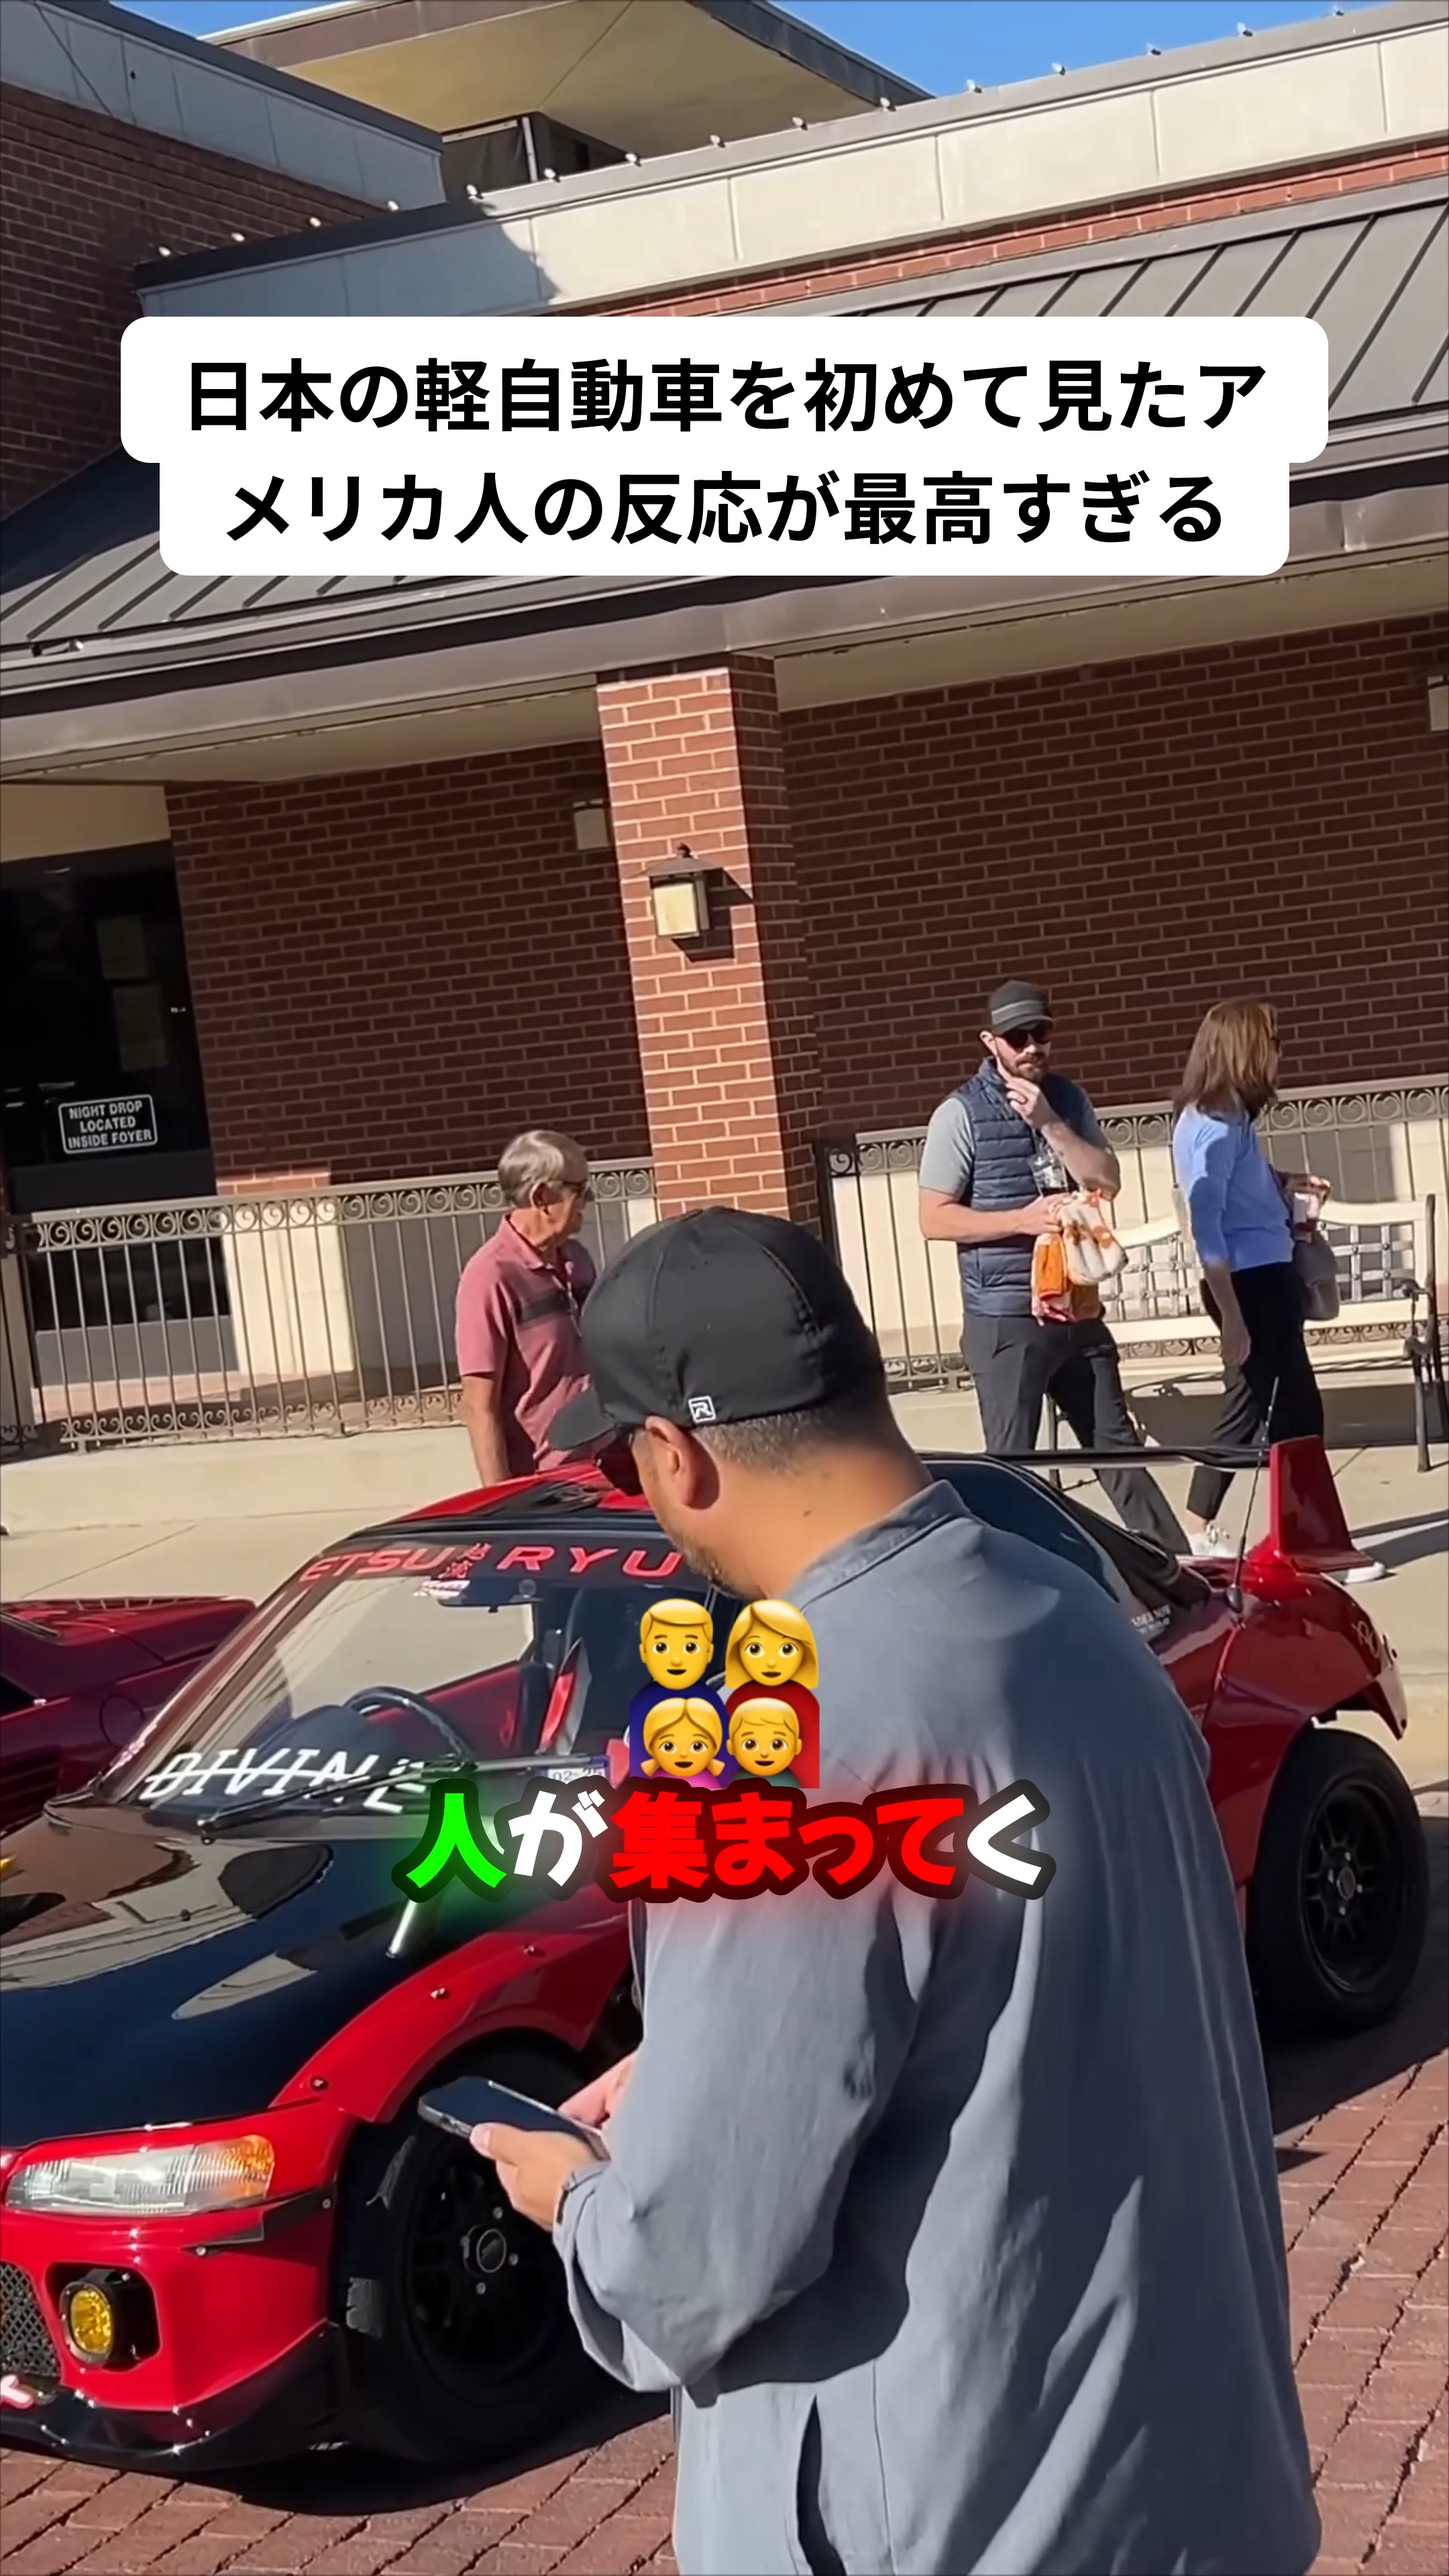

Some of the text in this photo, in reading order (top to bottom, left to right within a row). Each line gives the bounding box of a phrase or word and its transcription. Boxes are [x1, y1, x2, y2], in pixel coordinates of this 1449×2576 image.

[69, 1100, 142, 1120] NIGHT DROP
[80, 1116, 136, 1133] LOCATED
[68, 1129, 152, 1148] INSIDE FOYER
[496, 1546, 683, 1577] RYU
